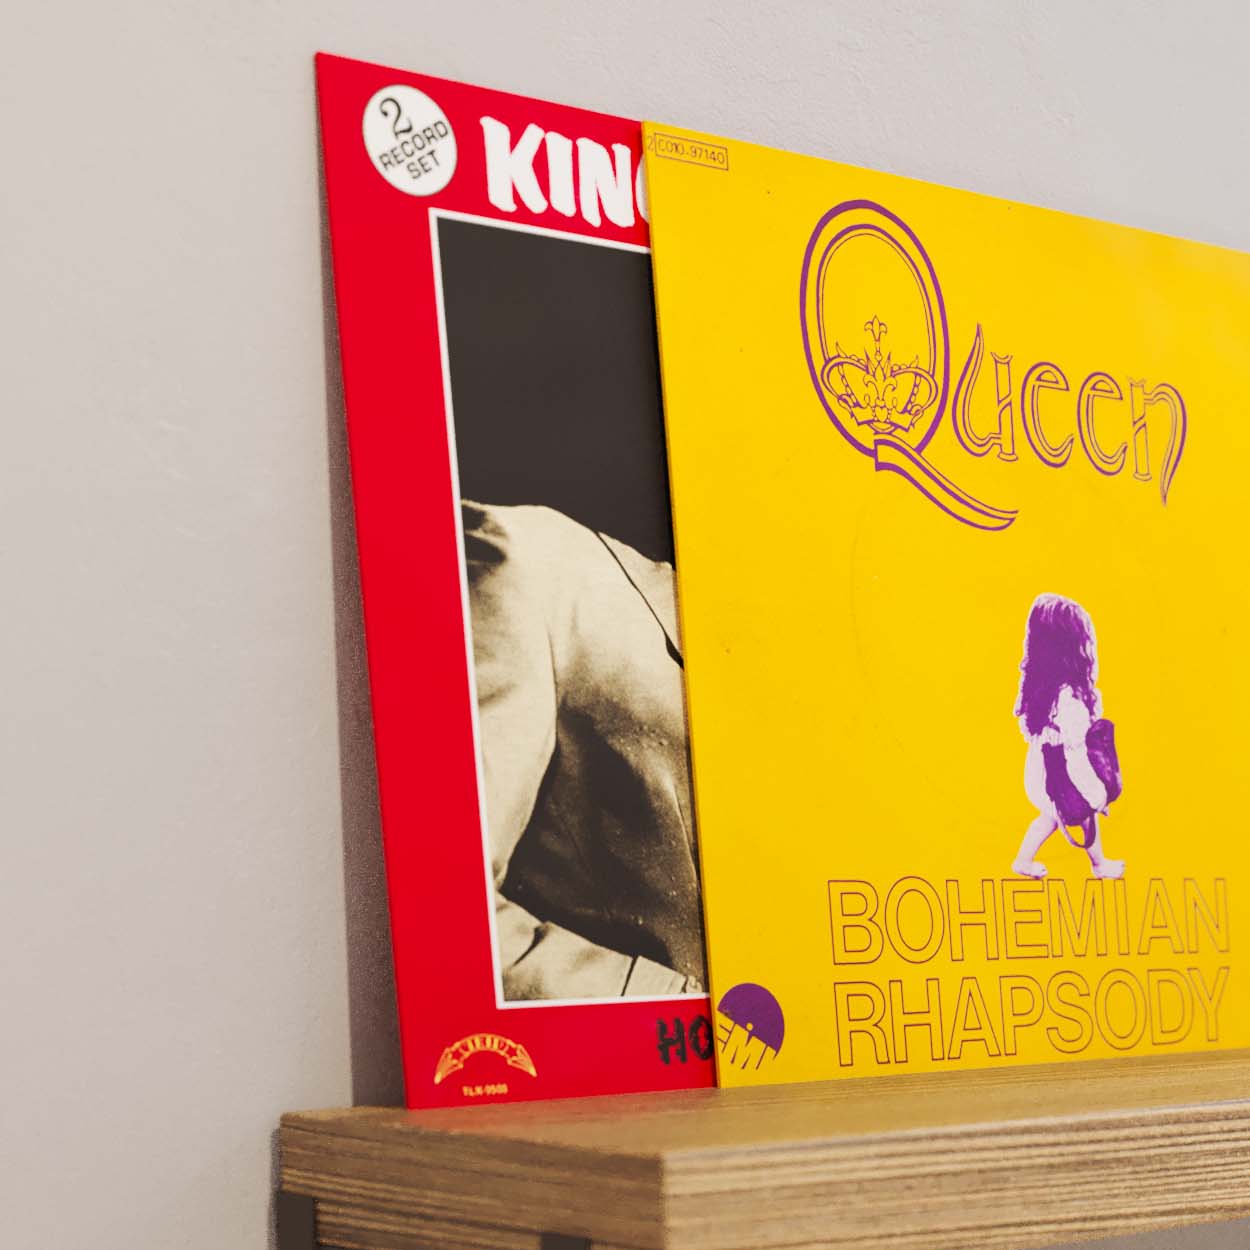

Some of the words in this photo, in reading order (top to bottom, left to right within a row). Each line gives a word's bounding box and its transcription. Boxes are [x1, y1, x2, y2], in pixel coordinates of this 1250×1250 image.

[379, 97, 413, 140] 2
[379, 121, 448, 170] RECORD
[406, 149, 439, 179] SET
[480, 116, 652, 228] KIN
[800, 199, 1188, 531] Queen
[828, 875, 1230, 965] BOHEMIAN
[833, 967, 1230, 1067] RHAPSODY
